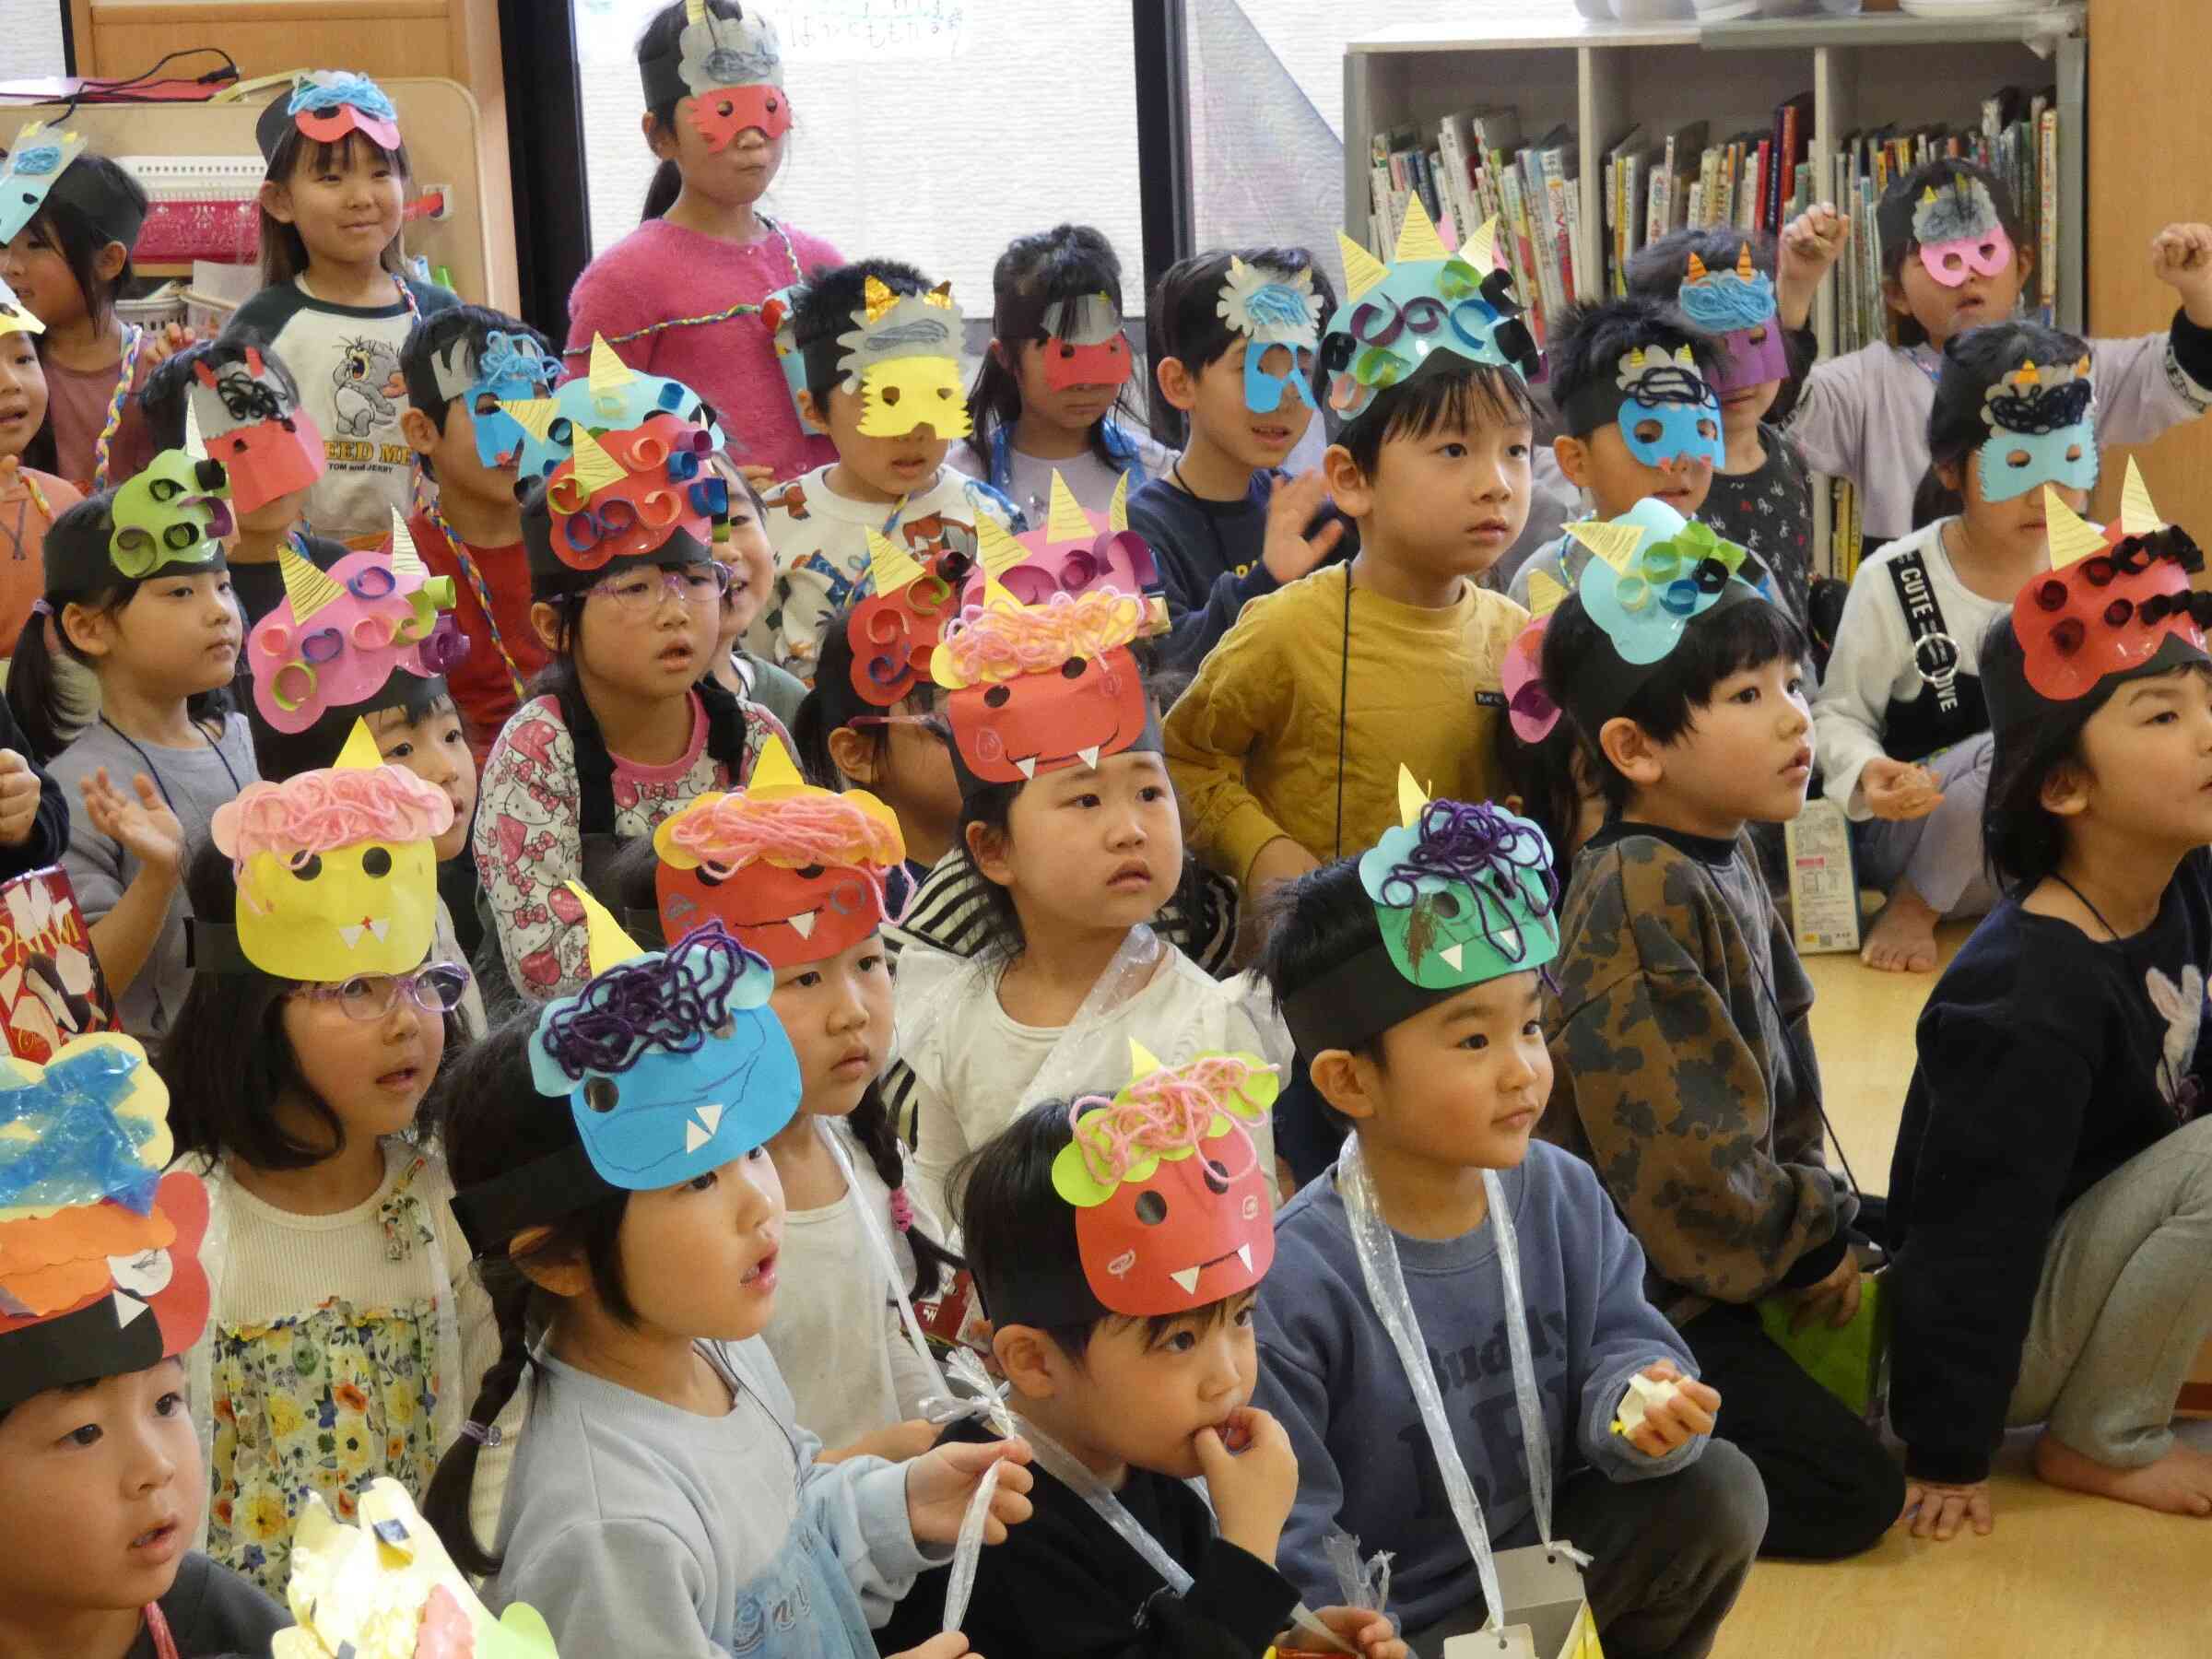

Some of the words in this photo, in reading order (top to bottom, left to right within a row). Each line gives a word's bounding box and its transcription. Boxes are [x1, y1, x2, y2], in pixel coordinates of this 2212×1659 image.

[324, 441, 373, 461] EED
[328, 463, 347, 471] TOM
[367, 464, 393, 474] JERRY
[1900, 567, 1935, 618] CUTE
